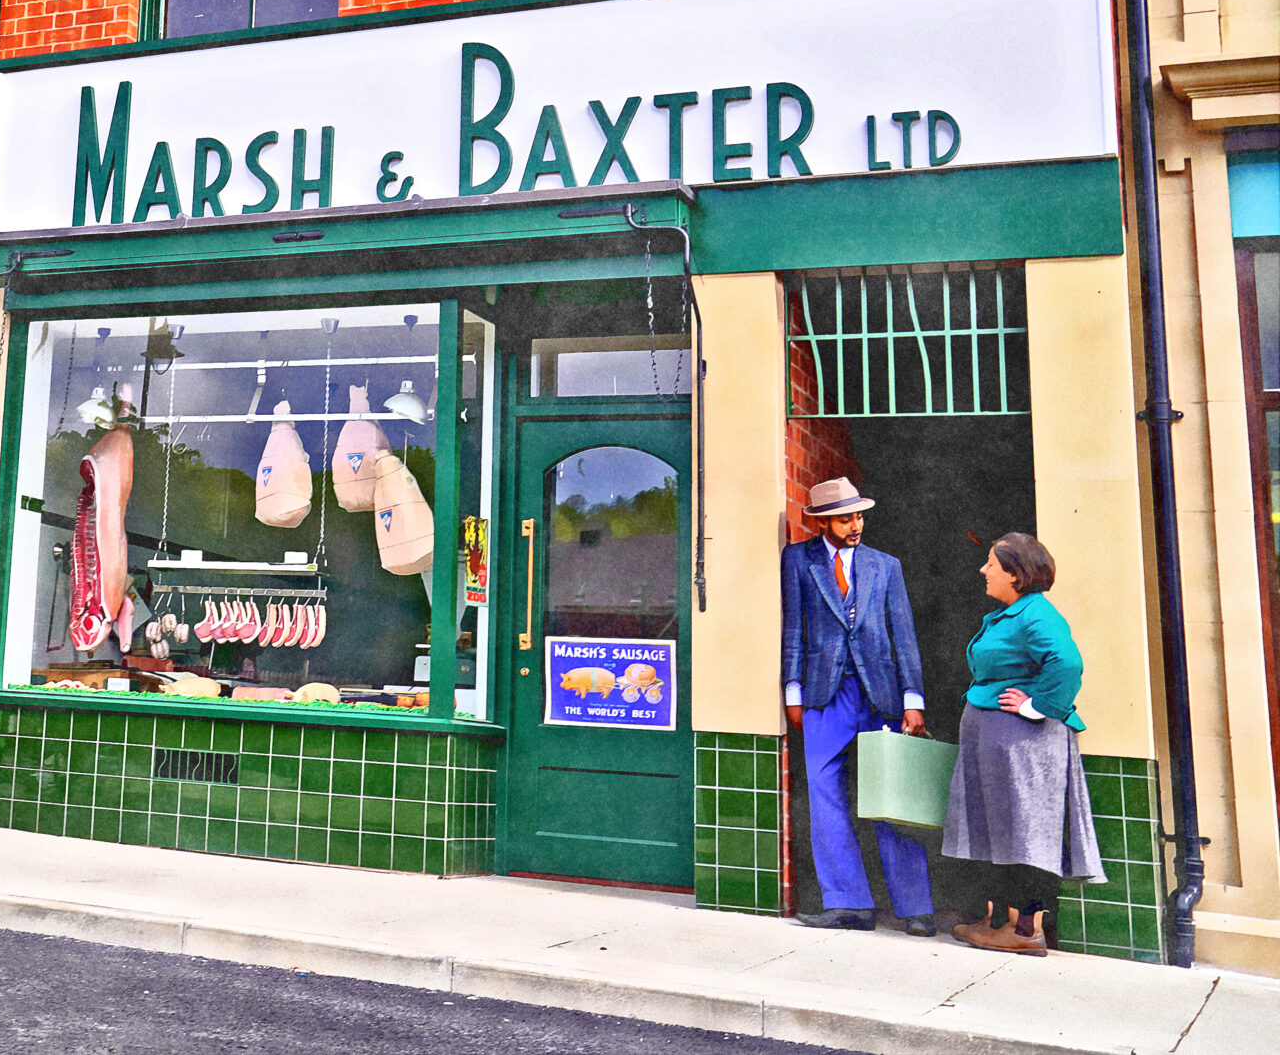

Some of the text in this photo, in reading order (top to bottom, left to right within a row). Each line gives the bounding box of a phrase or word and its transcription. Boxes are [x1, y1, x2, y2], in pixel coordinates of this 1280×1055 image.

[72, 42, 962, 227] MARSH & BAXTER LTD
[554, 644, 667, 662] MARSH'S SAUSAGE
[564, 706, 657, 719] THE WORLD'S BEST
